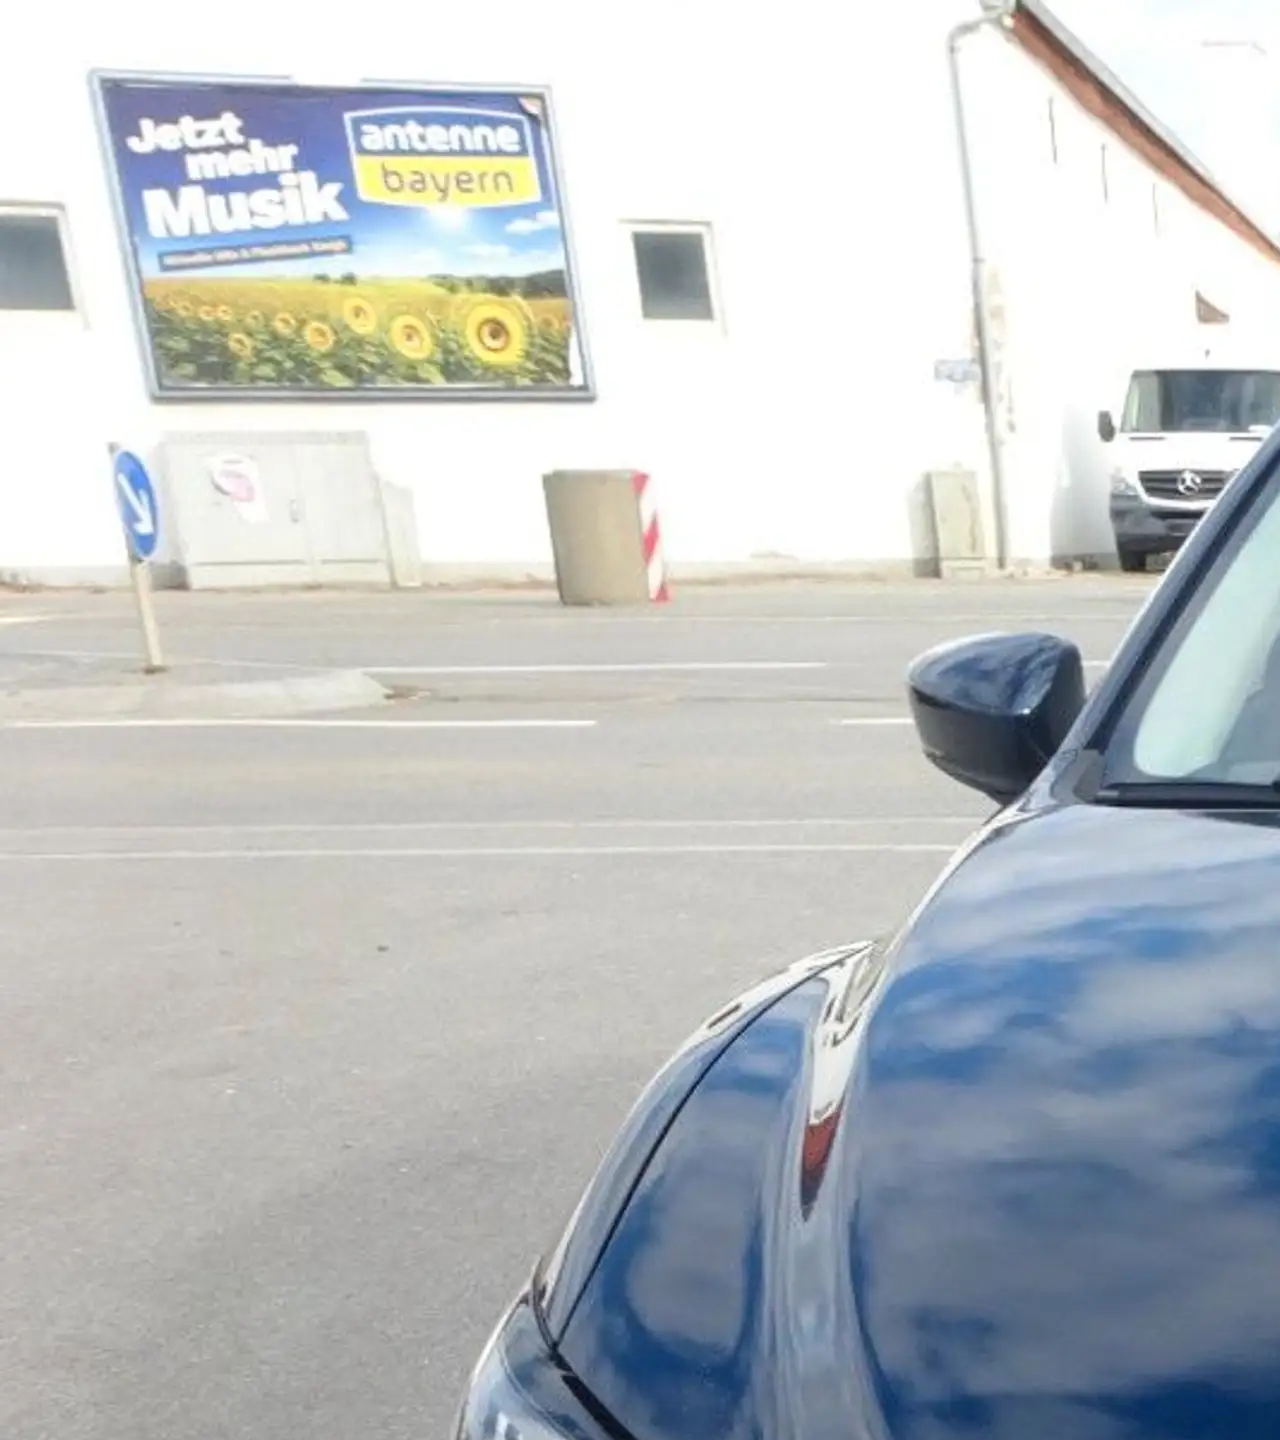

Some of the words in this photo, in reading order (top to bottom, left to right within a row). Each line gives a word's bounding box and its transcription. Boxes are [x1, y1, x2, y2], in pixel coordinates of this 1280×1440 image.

[125, 111, 246, 153] Jetzt
[360, 119, 521, 153] antenne
[185, 138, 299, 181] mehr
[381, 162, 515, 202] bayern
[141, 169, 349, 238] Musik
